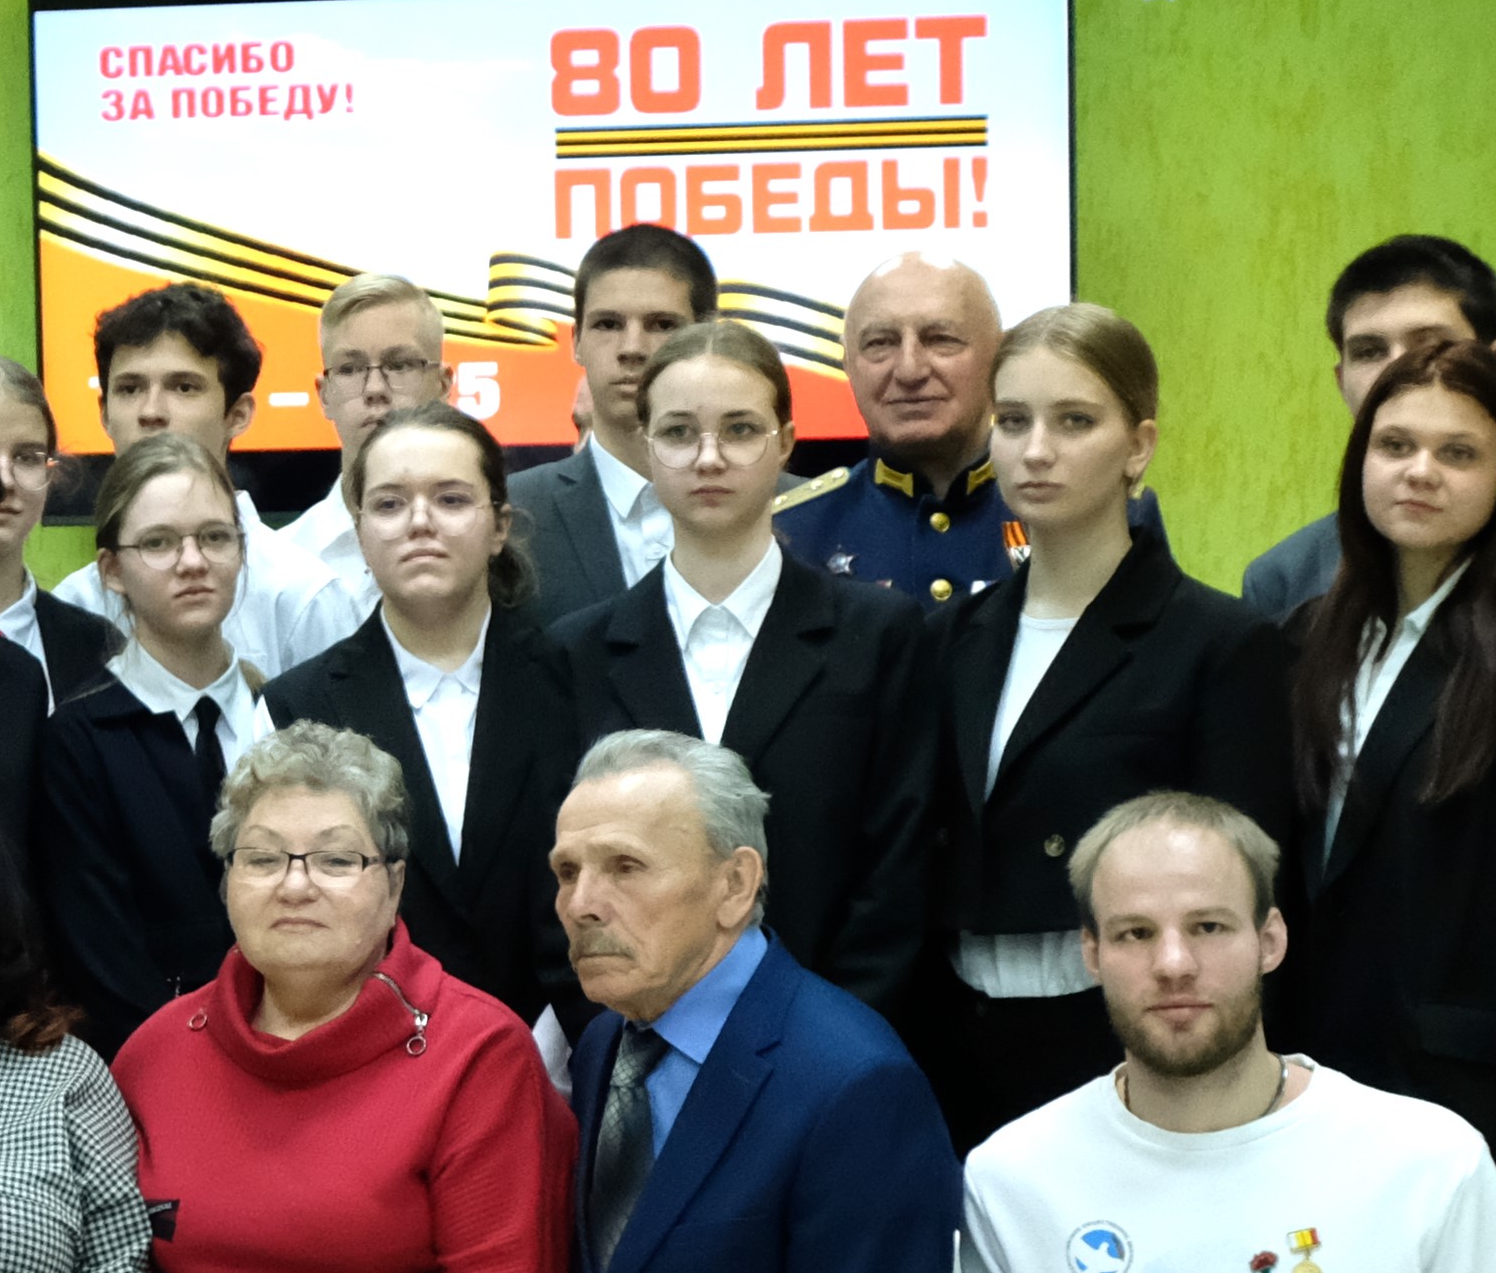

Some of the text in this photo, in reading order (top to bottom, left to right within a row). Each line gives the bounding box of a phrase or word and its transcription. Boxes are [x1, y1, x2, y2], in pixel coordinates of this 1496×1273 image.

[99, 41, 294, 79] СПАСИБО
[551, 15, 987, 116] 80 ЛЕТ
[102, 84, 353, 123] ЗА ПОБЕДУ!
[554, 157, 989, 240] ПОБЕДЫ!
